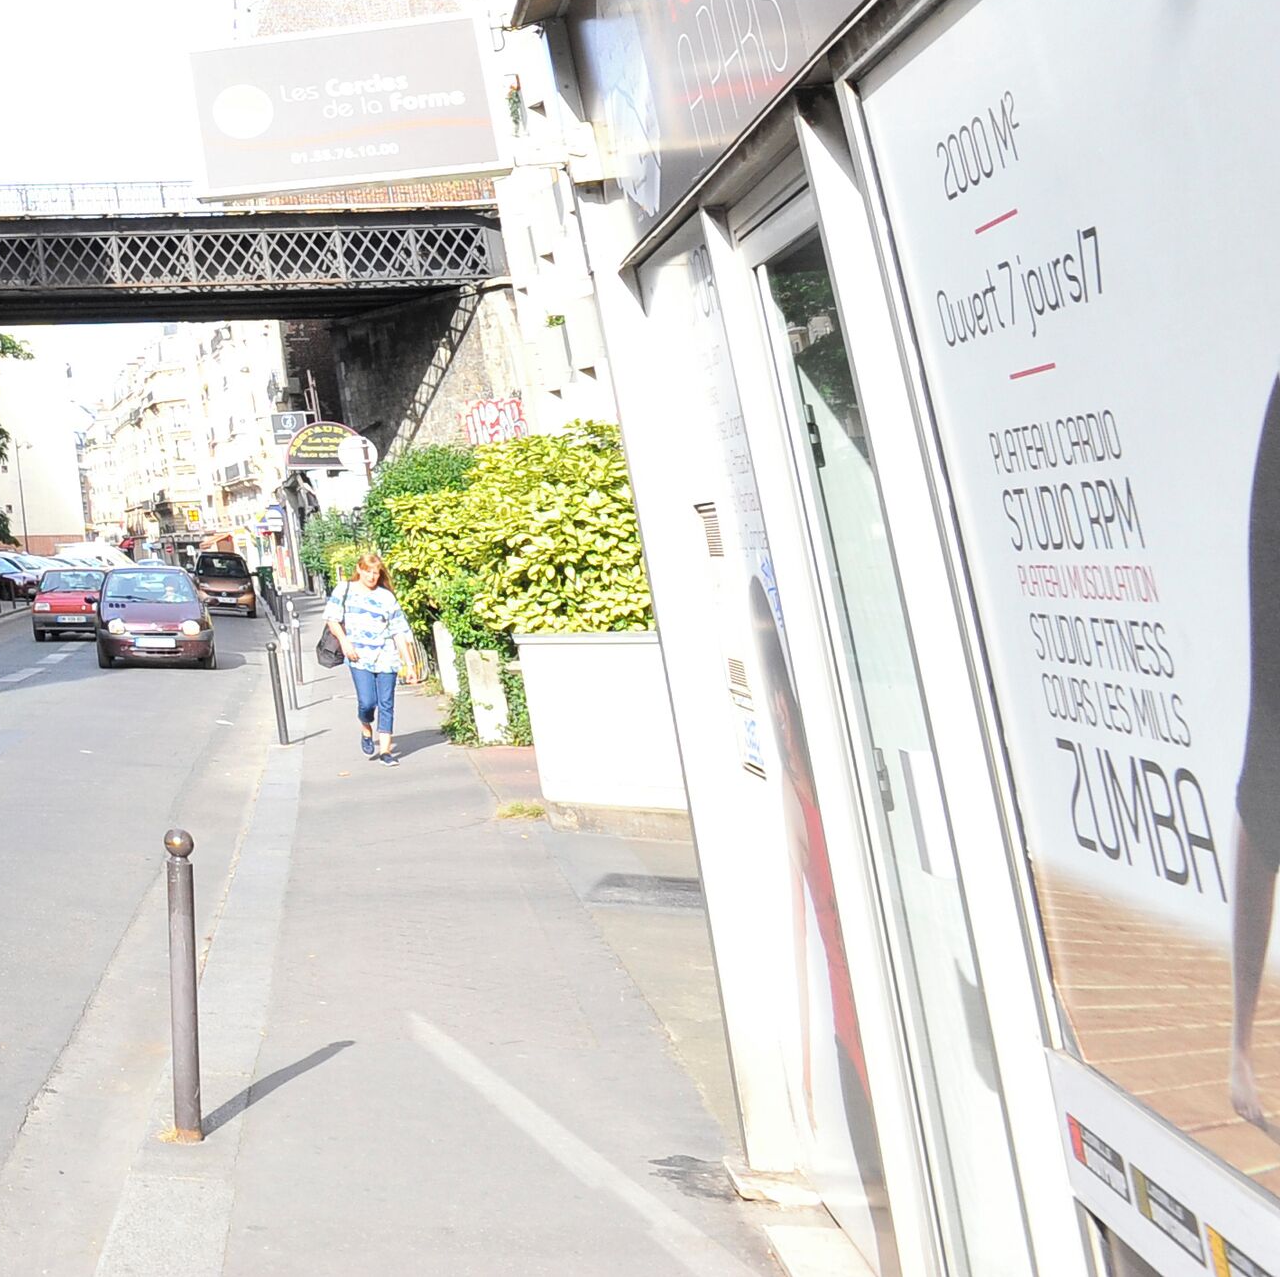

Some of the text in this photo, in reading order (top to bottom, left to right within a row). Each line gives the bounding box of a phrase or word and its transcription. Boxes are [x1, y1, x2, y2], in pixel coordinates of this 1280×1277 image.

[279, 73, 409, 103] Les Cercles
[322, 89, 467, 119] de la Forme
[936, 115, 995, 201] 2000
[936, 226, 1103, 348] Ouvert 7 jours/7
[988, 409, 1122, 475] PLATEAU CARDIO
[1002, 476, 1146, 552] STUDIO RPM
[1017, 564, 1160, 603] PLATEAU MUSCULATION
[1029, 612, 1175, 679] STUDIO FITNESS
[1041, 672, 1192, 748] COURS LES MILLS
[1055, 736, 1228, 904] ZUMBA
